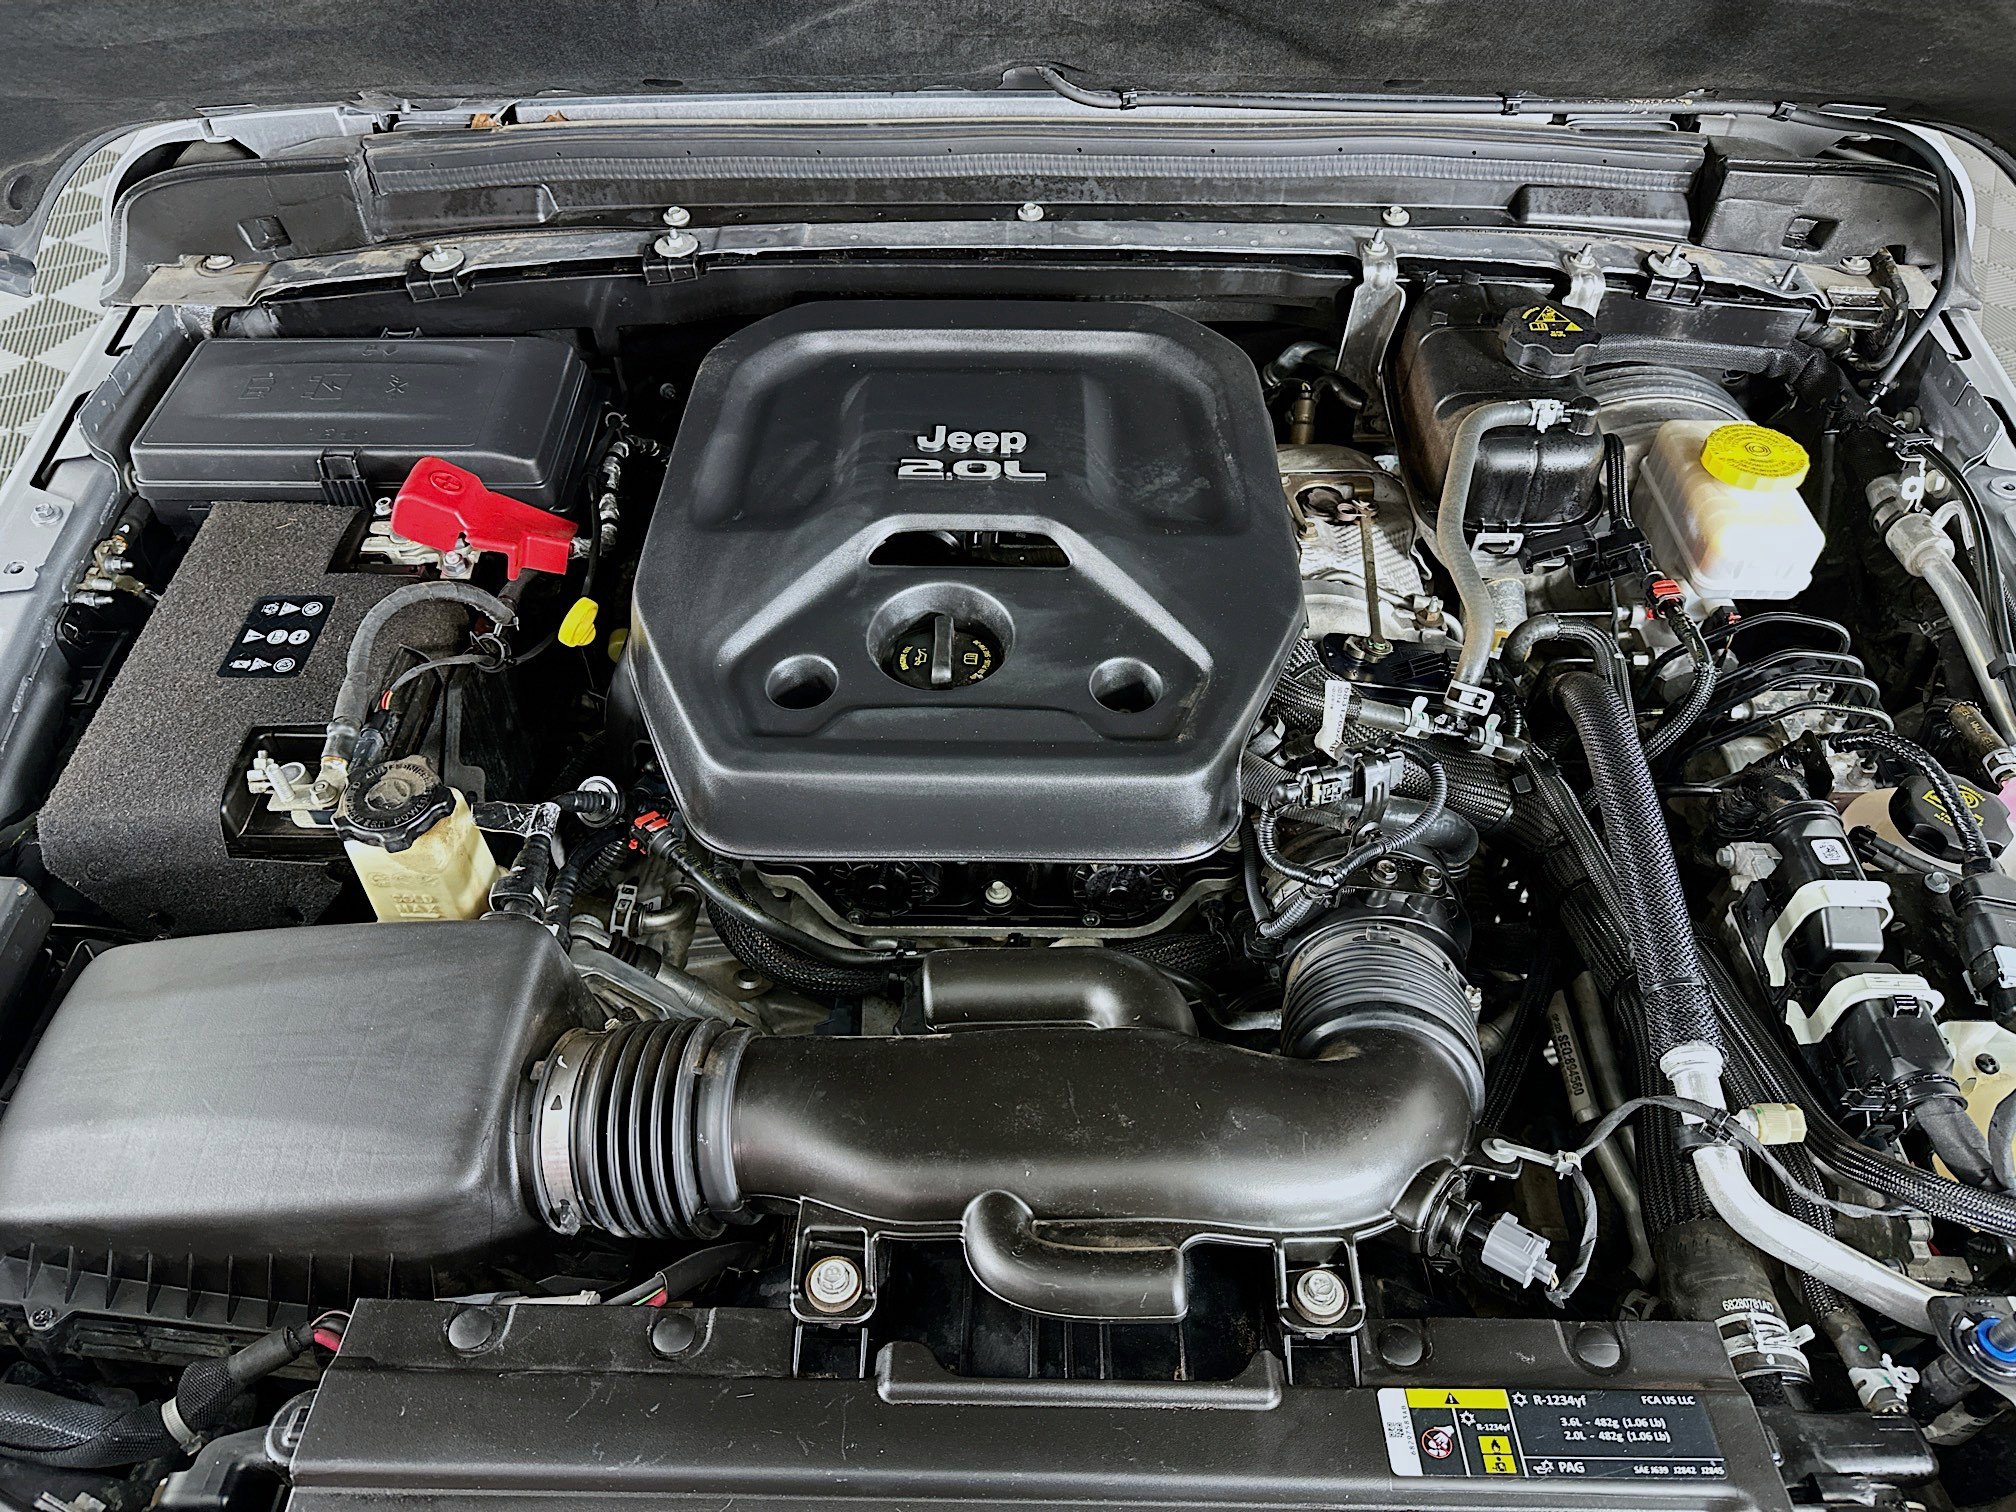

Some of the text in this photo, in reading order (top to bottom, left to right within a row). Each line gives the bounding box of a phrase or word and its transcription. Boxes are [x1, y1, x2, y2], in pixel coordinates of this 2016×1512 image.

[917, 425, 1027, 457] Jeep
[898, 459, 1047, 481] 2.0L
[393, 796, 430, 825] POWER
[1532, 1395, 1696, 1408] R-1234yf FCA US LLC
[1560, 1417, 1583, 1427] 3.6L
[1594, 1417, 1620, 1429] 482g
[1622, 1417, 1649, 1429] (1.06
[1563, 1430, 1587, 1441] 2.0L
[1598, 1431, 1625, 1443] 482g
[1626, 1431, 1653, 1443] (1.06
[1558, 1461, 1586, 1474] PAG
